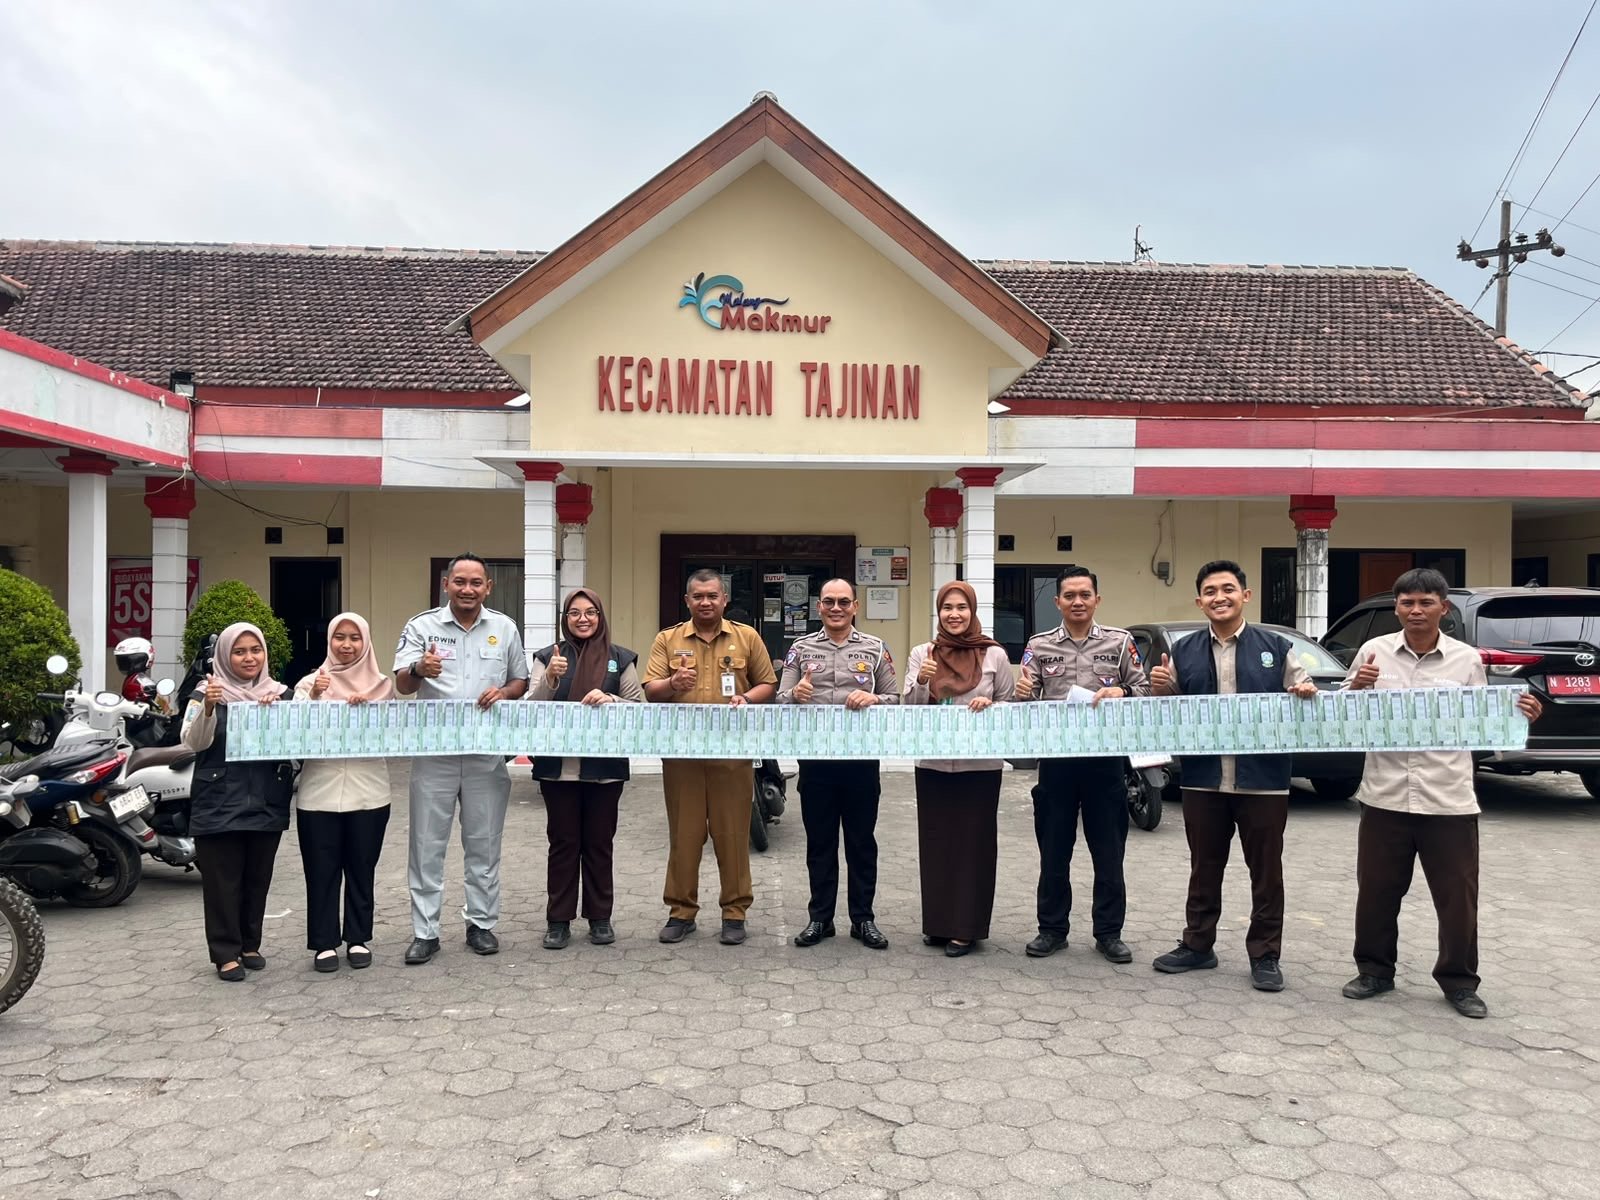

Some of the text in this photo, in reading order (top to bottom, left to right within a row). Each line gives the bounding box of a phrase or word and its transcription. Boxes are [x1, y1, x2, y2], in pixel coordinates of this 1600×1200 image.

[720, 306, 832, 333] Makmur
[598, 355, 920, 419] KECAMATAN TAJINAN
[114, 582, 151, 624] 5S
[428, 635, 457, 645] EDWIN
[848, 653, 872, 661] POLRI
[1040, 656, 1064, 665] NIZAR
[1093, 654, 1119, 662] POLRI
[1549, 676, 1558, 688] N
[1564, 676, 1592, 688] 1283
